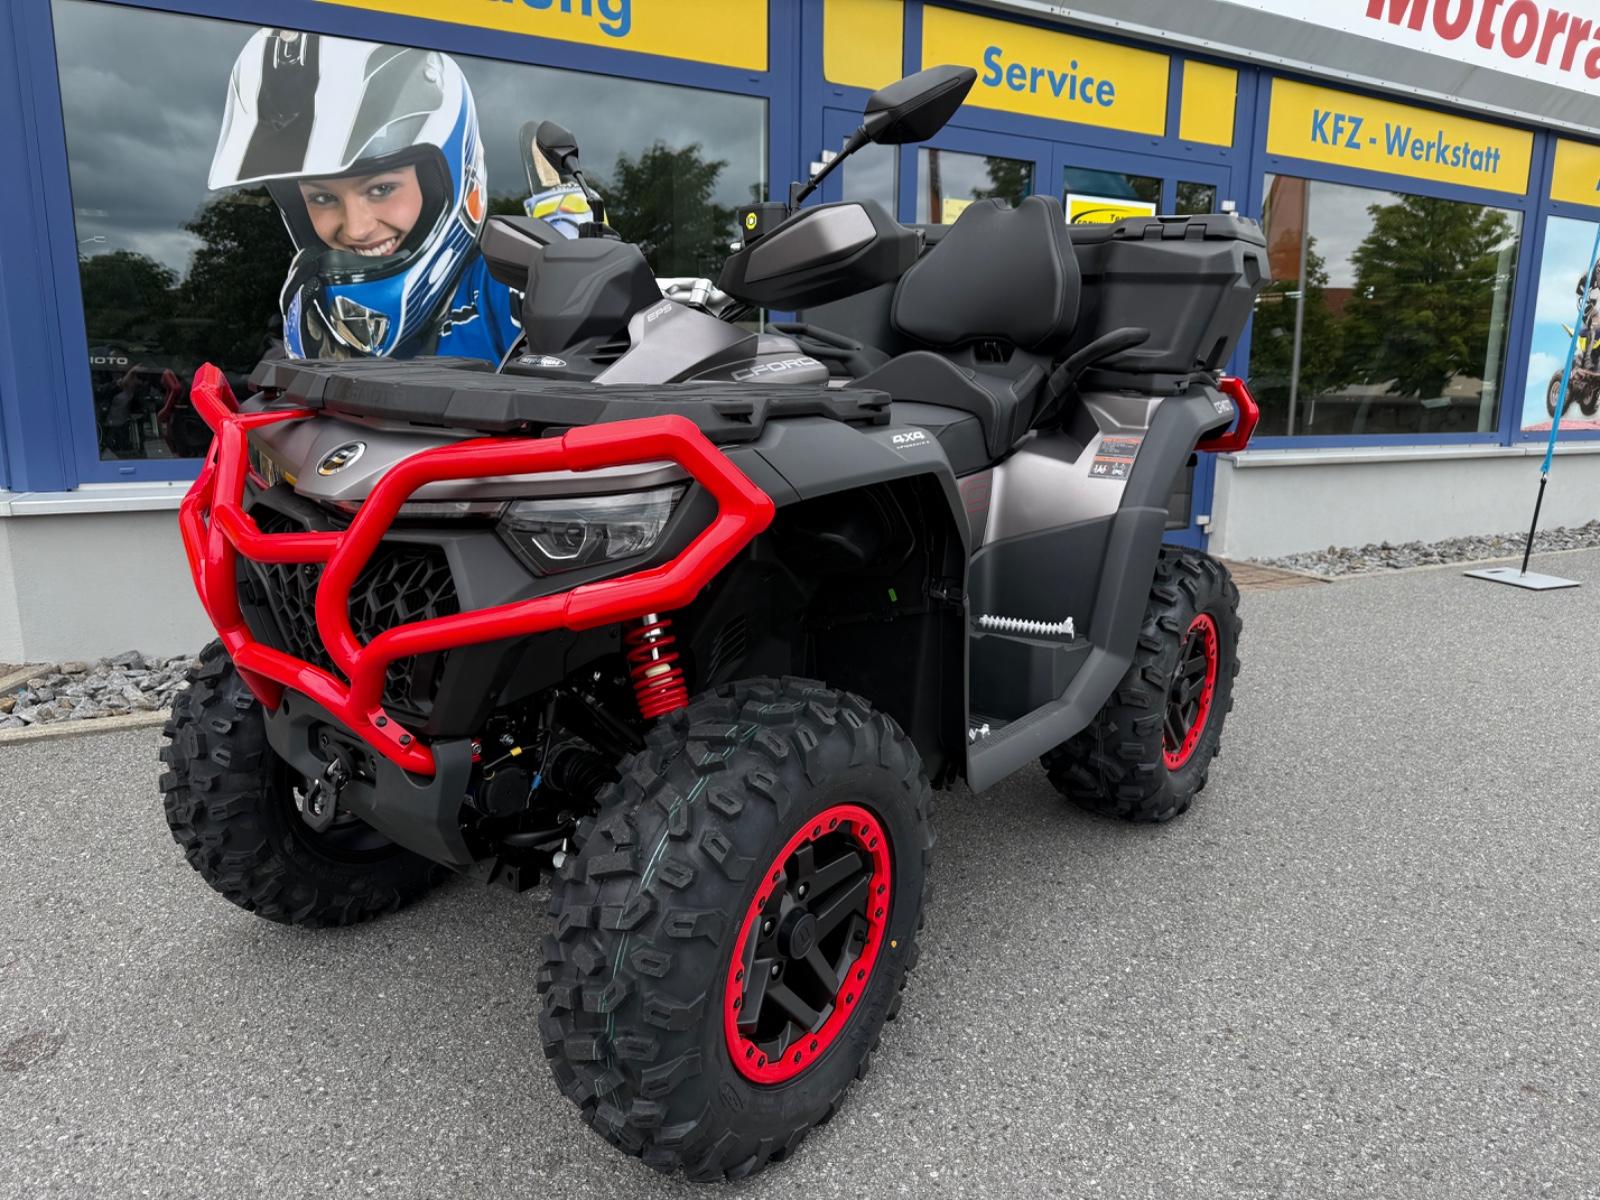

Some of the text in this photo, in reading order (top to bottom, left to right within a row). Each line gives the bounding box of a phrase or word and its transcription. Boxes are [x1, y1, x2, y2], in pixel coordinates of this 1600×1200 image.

[982, 46, 1115, 107] Service
[1311, 109, 1364, 150] KFZ
[1385, 123, 1500, 173] Werkstatt
[90, 356, 128, 365] OTO
